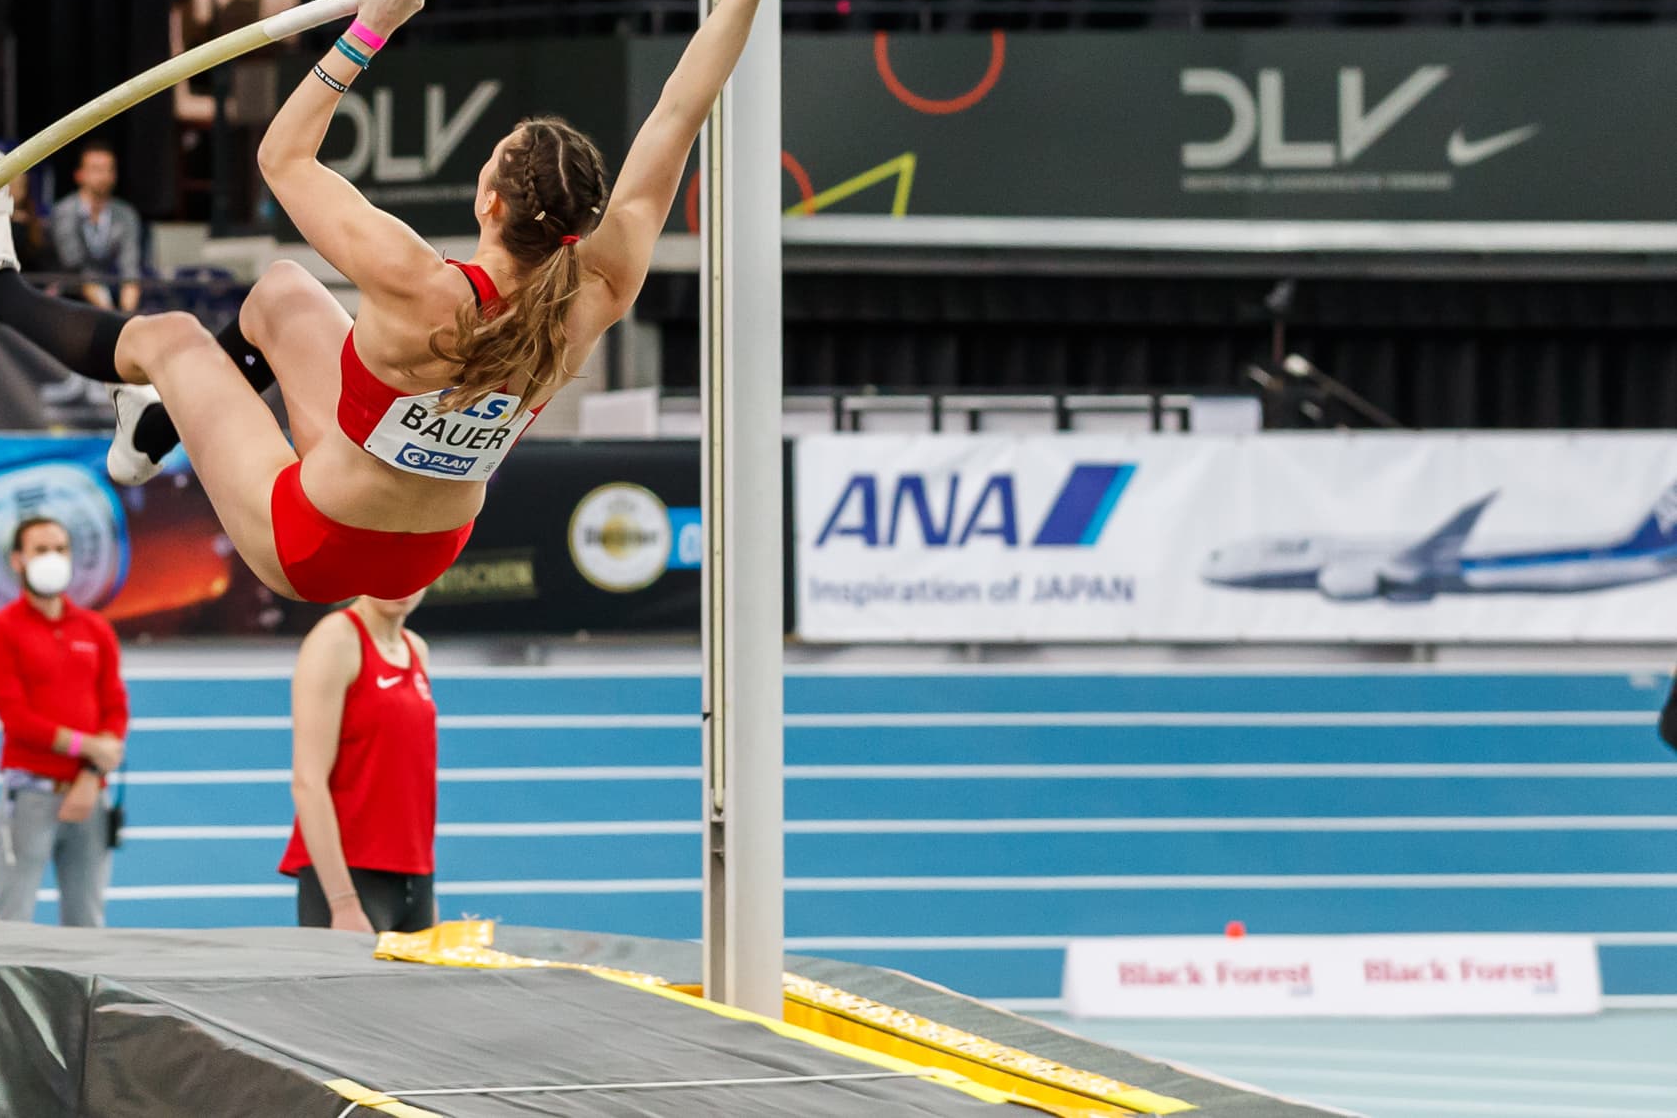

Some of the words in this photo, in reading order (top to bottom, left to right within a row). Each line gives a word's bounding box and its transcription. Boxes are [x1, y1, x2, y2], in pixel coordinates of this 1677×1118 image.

[1180, 65, 1451, 169] DLV
[400, 402, 511, 450] BAUER
[430, 455, 473, 470] PLAN
[814, 473, 1019, 548] ANA
[808, 575, 981, 606] Inspiration
[987, 576, 1020, 602] of
[1031, 575, 1137, 602] JAPAN
[1118, 960, 1204, 986] Black
[1216, 961, 1312, 985] Forest
[1363, 957, 1449, 983] Black
[1460, 958, 1557, 984] Forest
